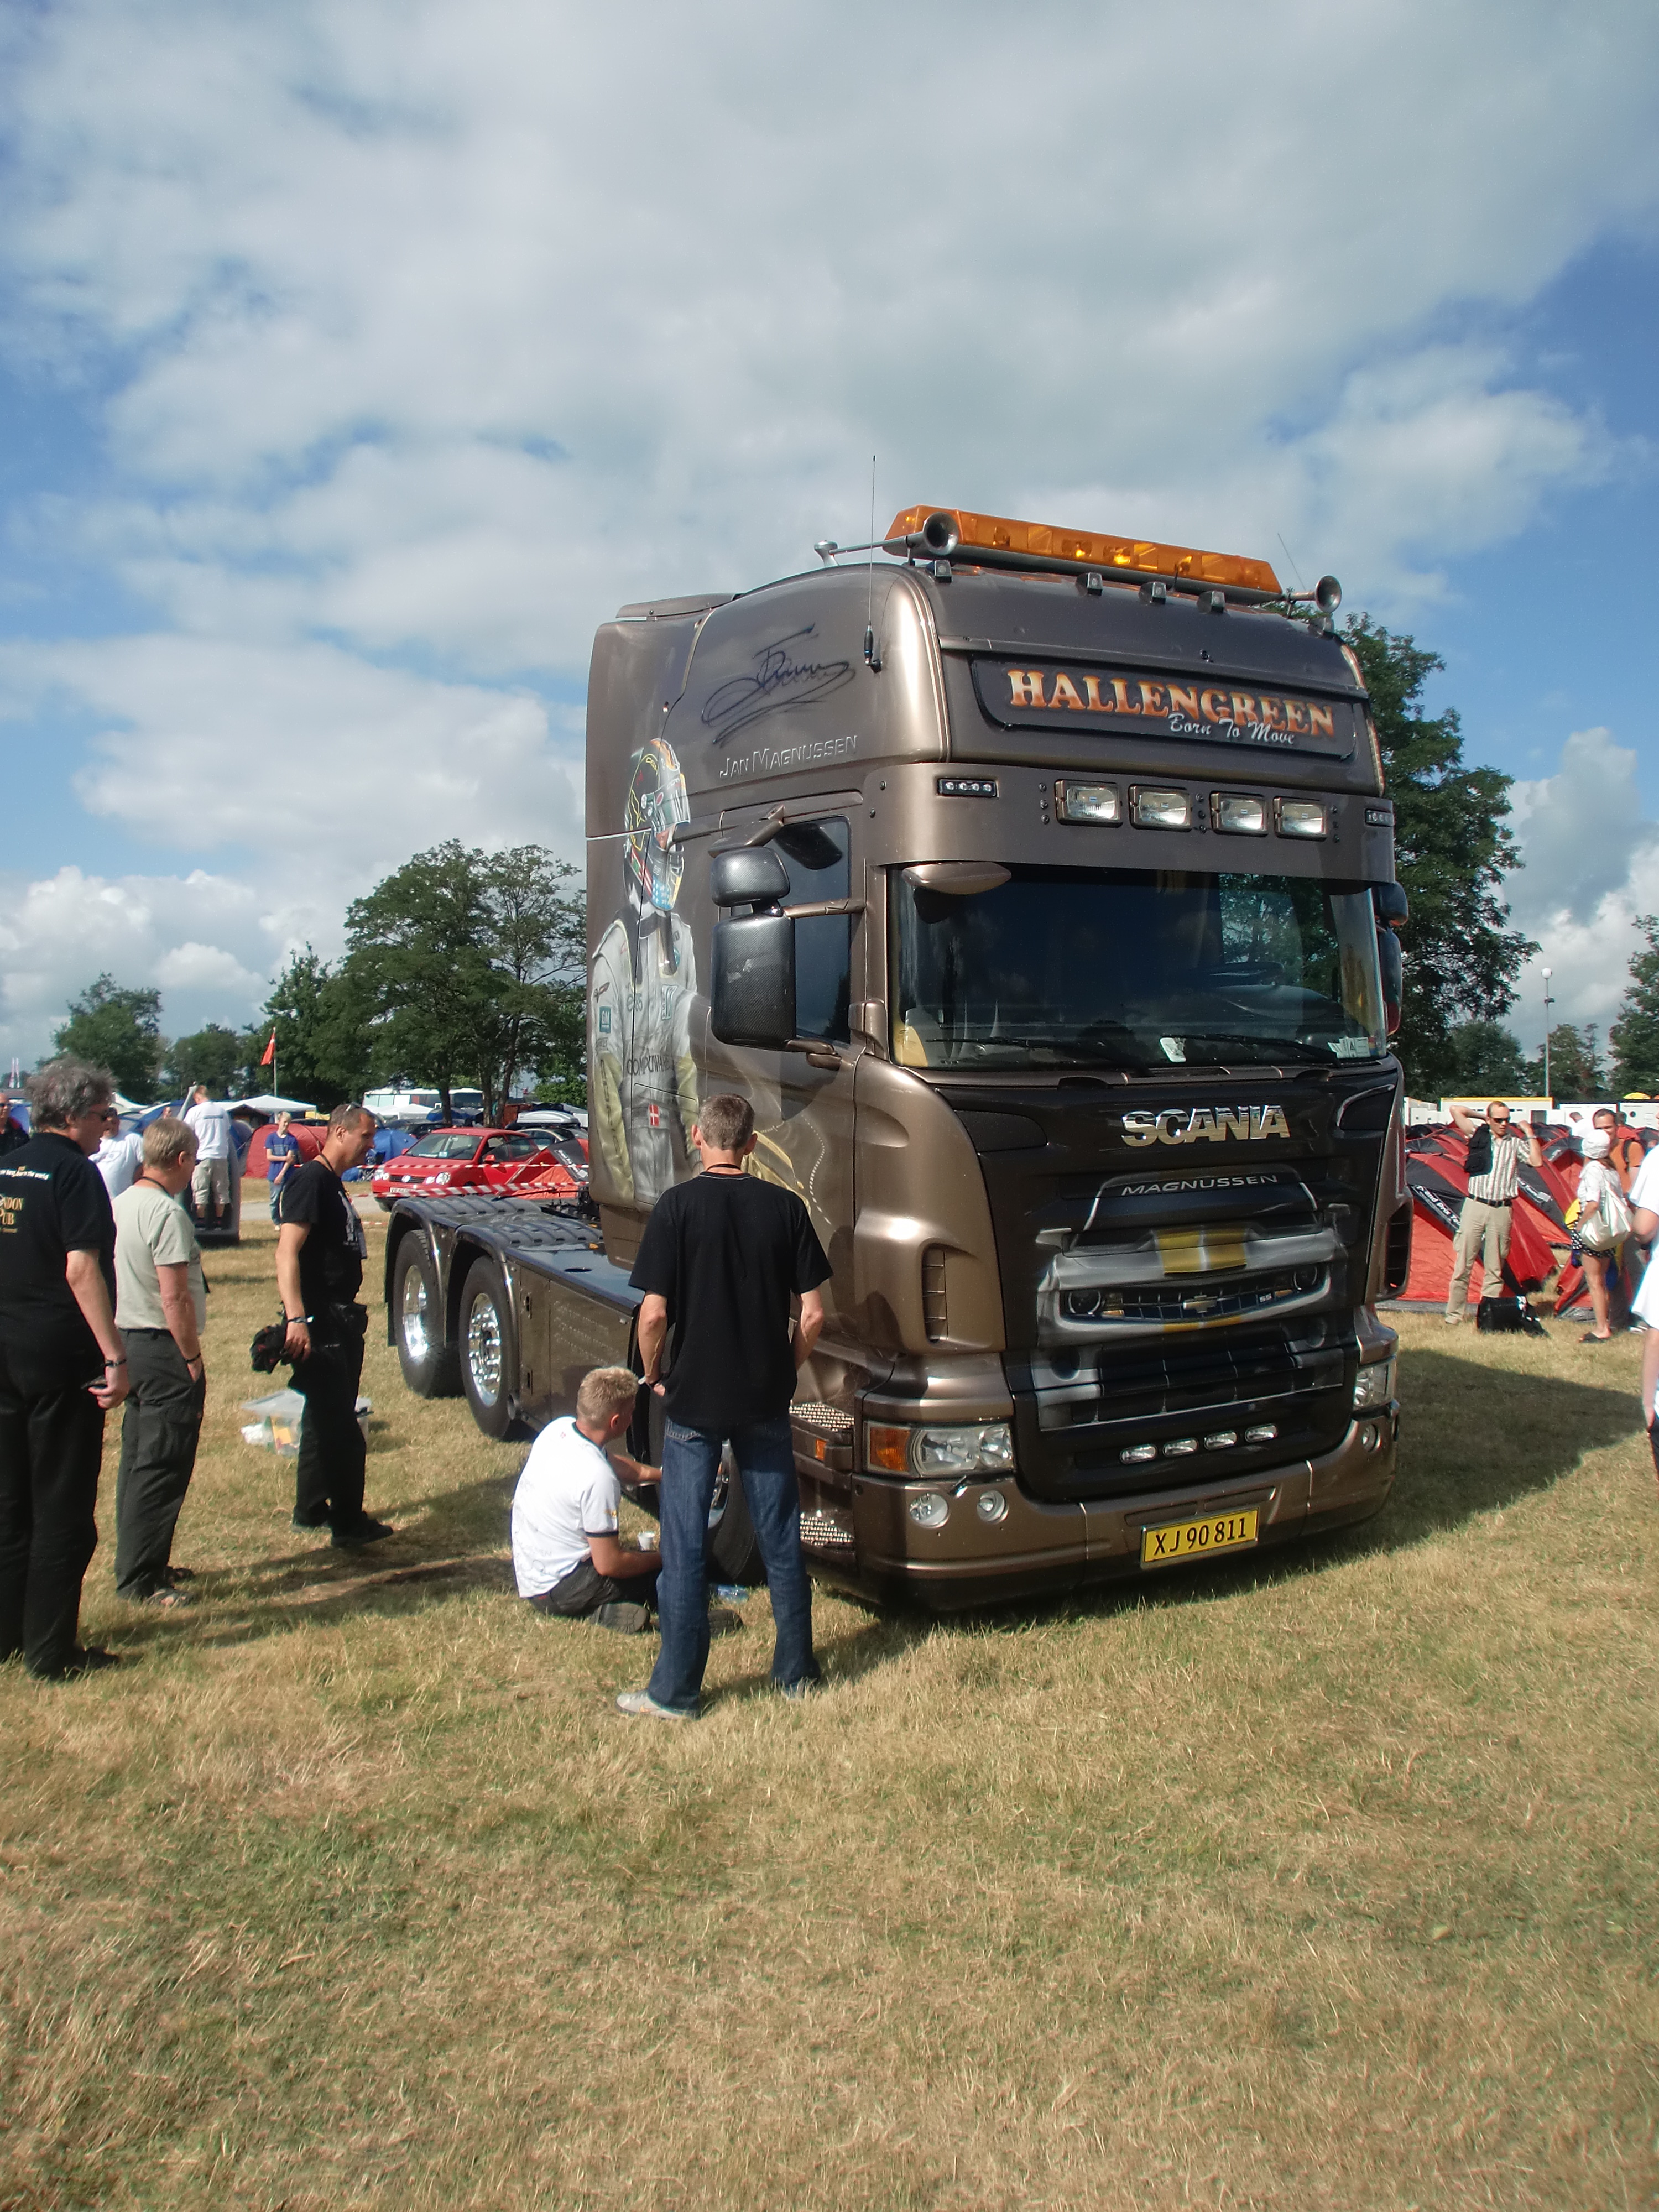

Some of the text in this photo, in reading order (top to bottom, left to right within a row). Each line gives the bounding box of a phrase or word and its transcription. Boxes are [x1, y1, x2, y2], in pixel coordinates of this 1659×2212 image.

[1007, 669, 1334, 737] HALLENGREEN
[1168, 713, 1295, 745] Born To Move
[1121, 1105, 1290, 1146] SCANIA
[1121, 1175, 1278, 1196] MAGNUSSEN
[1154, 1518, 1246, 1556] XJ 90 811
